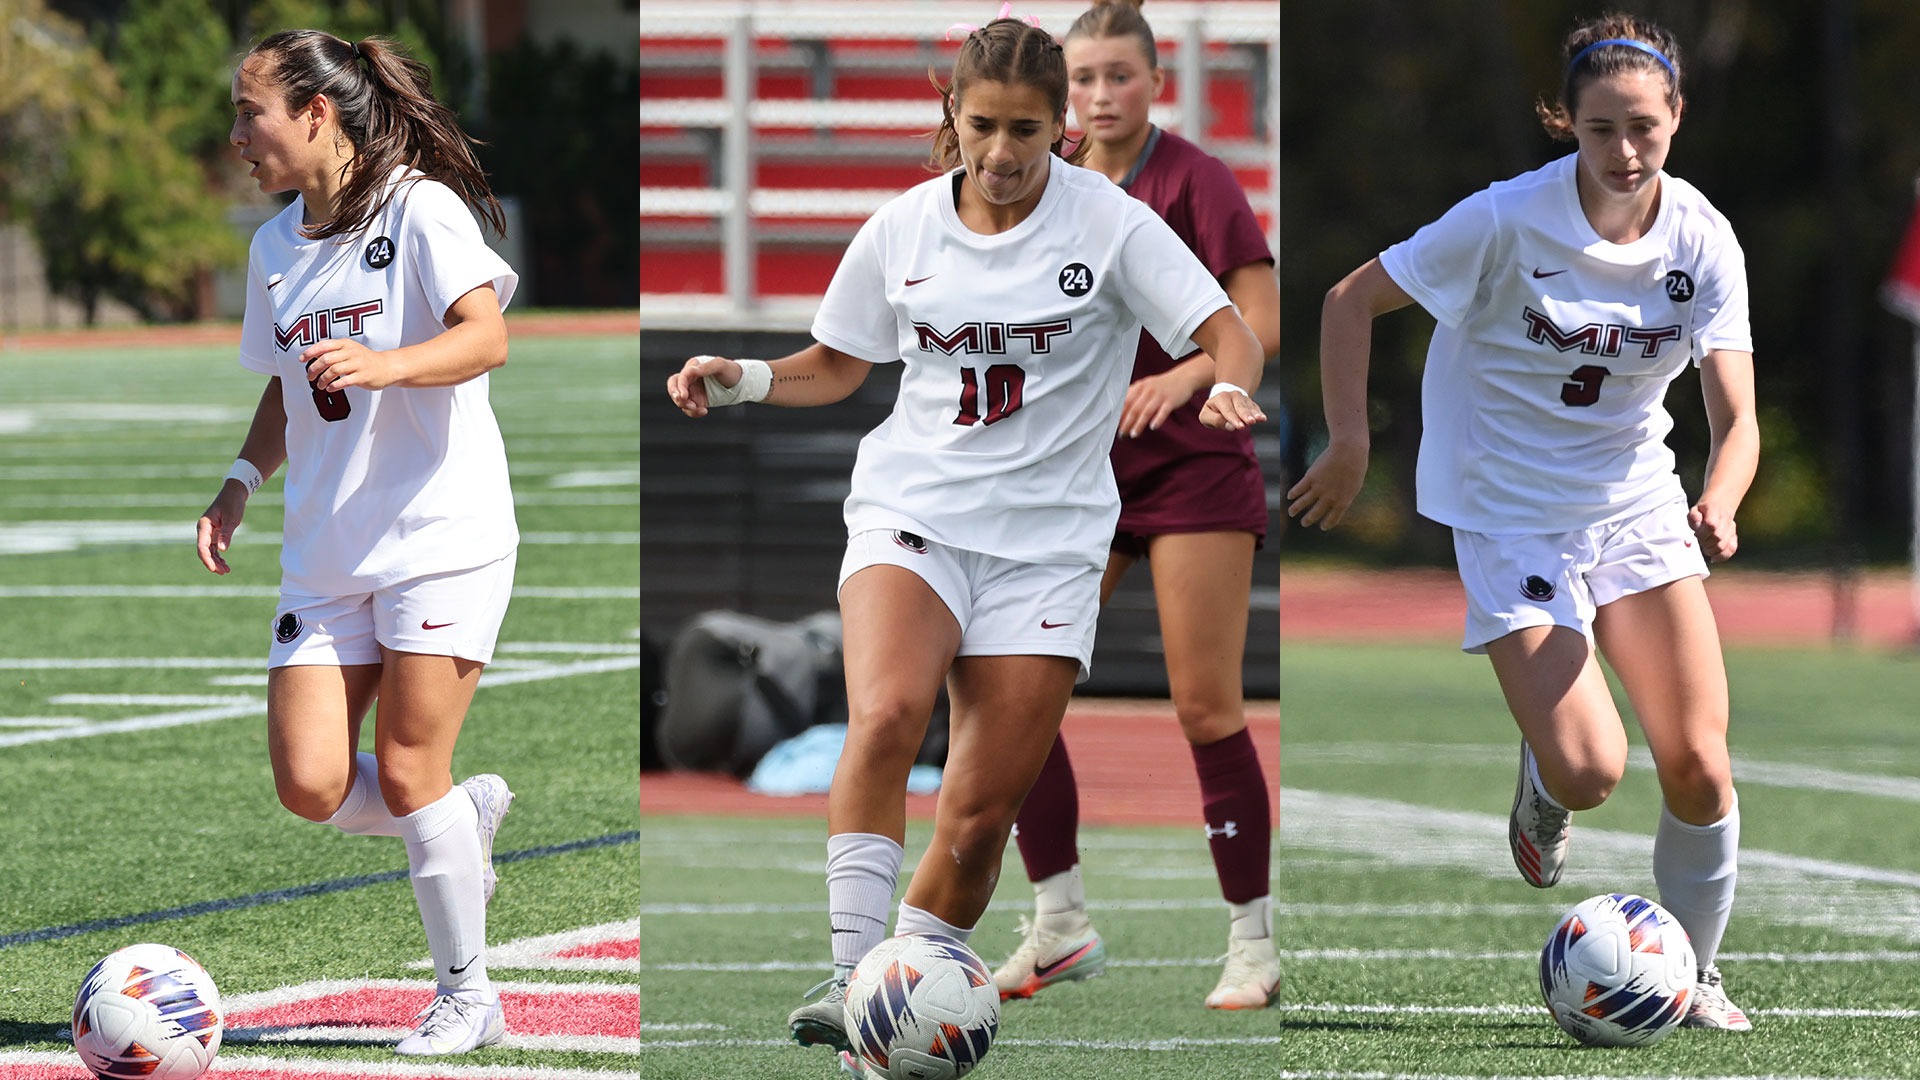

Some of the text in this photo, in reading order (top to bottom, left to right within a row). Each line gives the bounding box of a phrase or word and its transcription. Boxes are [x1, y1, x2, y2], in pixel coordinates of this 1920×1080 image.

[369, 240, 392, 263] 24
[1063, 268, 1089, 290] 24
[1666, 276, 1690, 296] 24
[275, 299, 383, 352] MIT
[911, 318, 1072, 356] MIT
[1522, 305, 1682, 358] MIT
[952, 364, 1026, 426] 10
